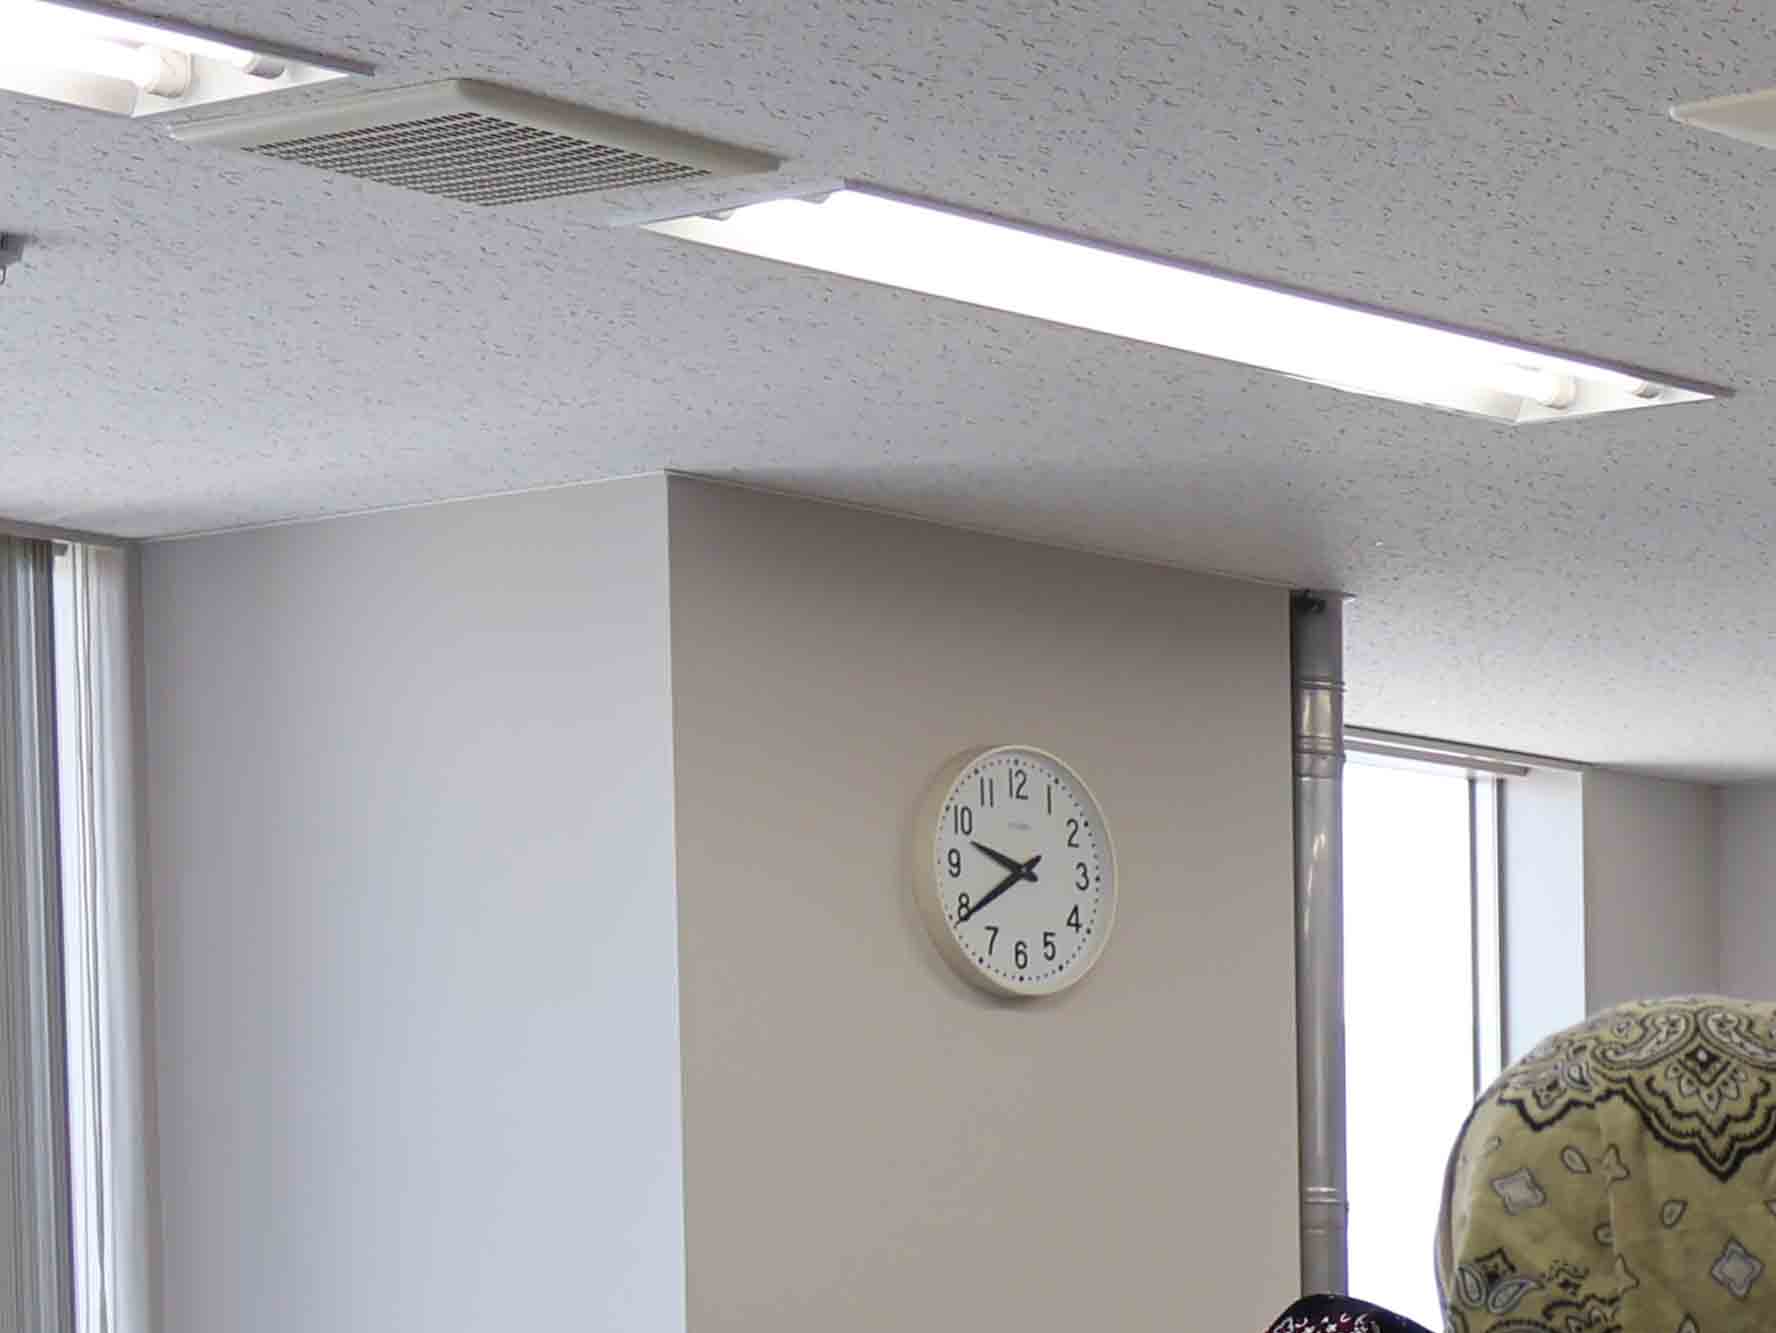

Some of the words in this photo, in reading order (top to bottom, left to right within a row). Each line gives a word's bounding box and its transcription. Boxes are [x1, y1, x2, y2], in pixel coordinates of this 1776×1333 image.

[1008, 767, 1029, 800] 12
[953, 804, 973, 836] 10
[1066, 818, 1080, 849] 2
[947, 849, 962, 878] 9
[1075, 862, 1090, 891] 3
[957, 892, 971, 922] 8
[1066, 904, 1083, 934] 4
[985, 925, 999, 956] 7
[1014, 940, 1028, 970] 6
[1043, 931, 1057, 961] 5
